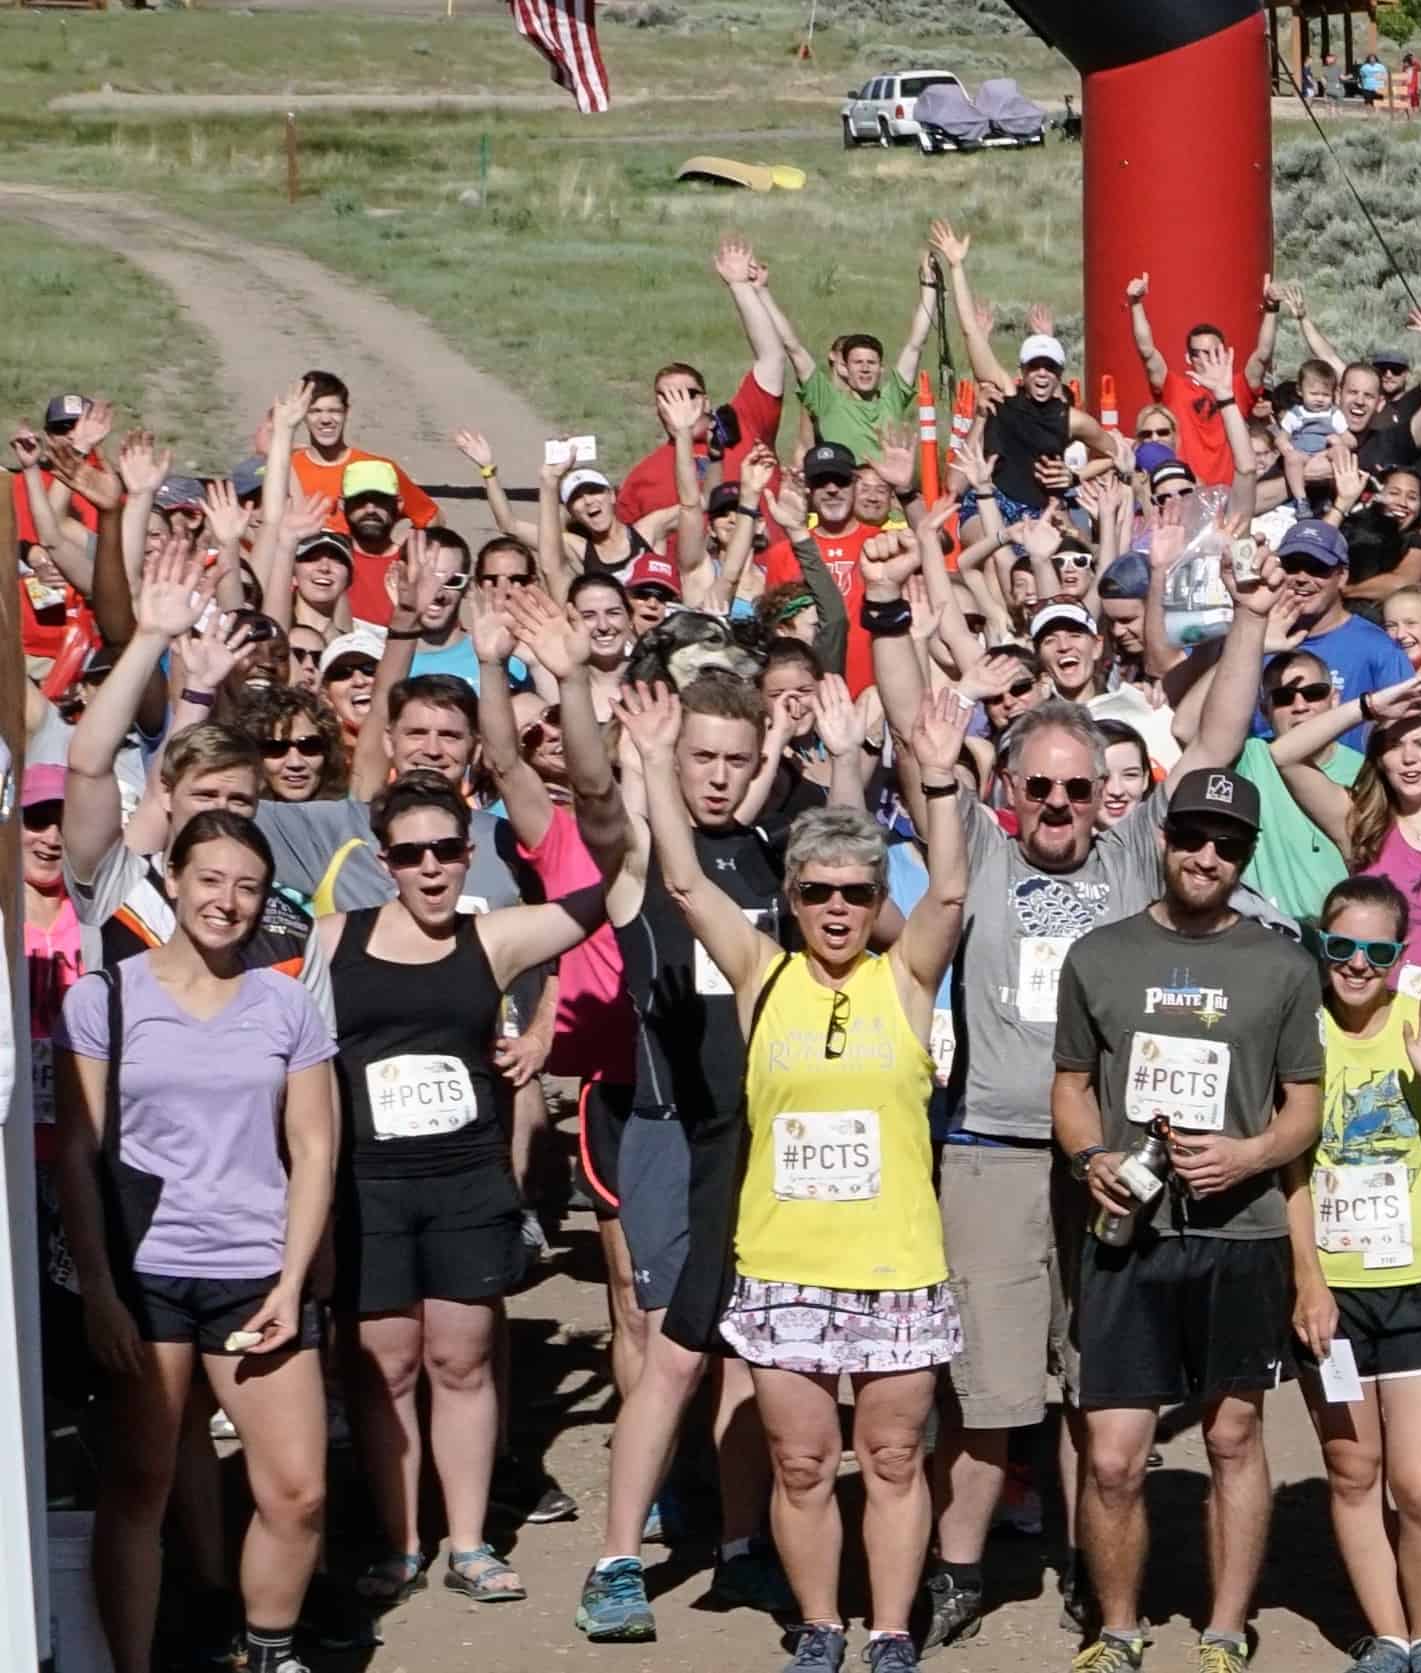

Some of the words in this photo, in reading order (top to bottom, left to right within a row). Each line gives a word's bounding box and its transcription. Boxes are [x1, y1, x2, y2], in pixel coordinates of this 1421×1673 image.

[380, 1079, 464, 1110] #PCTS
[1134, 1065, 1218, 1099] #PCTS
[783, 1143, 870, 1171] #PCTS
[1320, 1195, 1400, 1222] #PCTS
